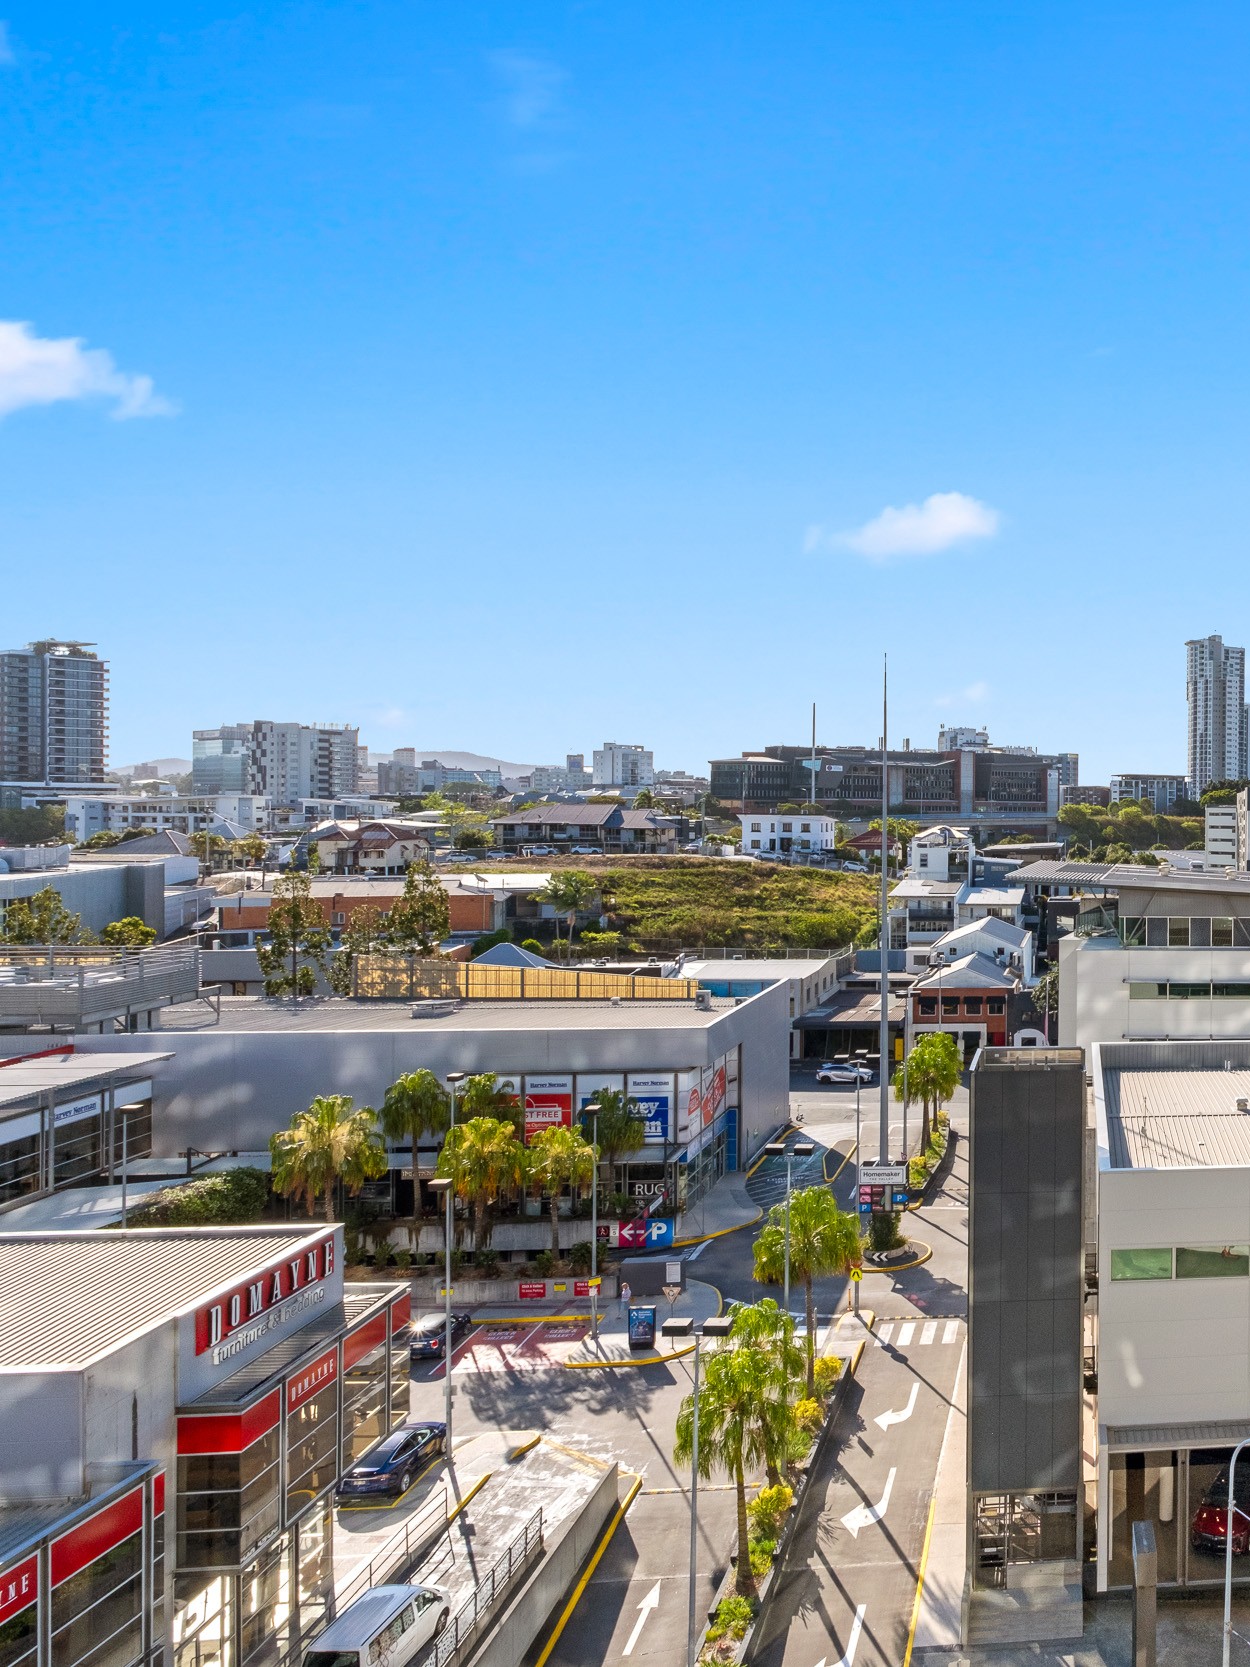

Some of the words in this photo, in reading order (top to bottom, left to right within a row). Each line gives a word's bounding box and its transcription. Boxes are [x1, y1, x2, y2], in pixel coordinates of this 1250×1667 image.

[53, 1109, 72, 1121] arvey
[73, 1102, 97, 1115] Norman
[536, 1111, 559, 1119] FREE
[651, 1222, 668, 1241] P
[210, 1240, 333, 1347] DOMAYNE
[212, 1324, 268, 1366] furniture
[280, 1286, 326, 1323] bedding
[291, 1358, 333, 1402] DOMAYNE
